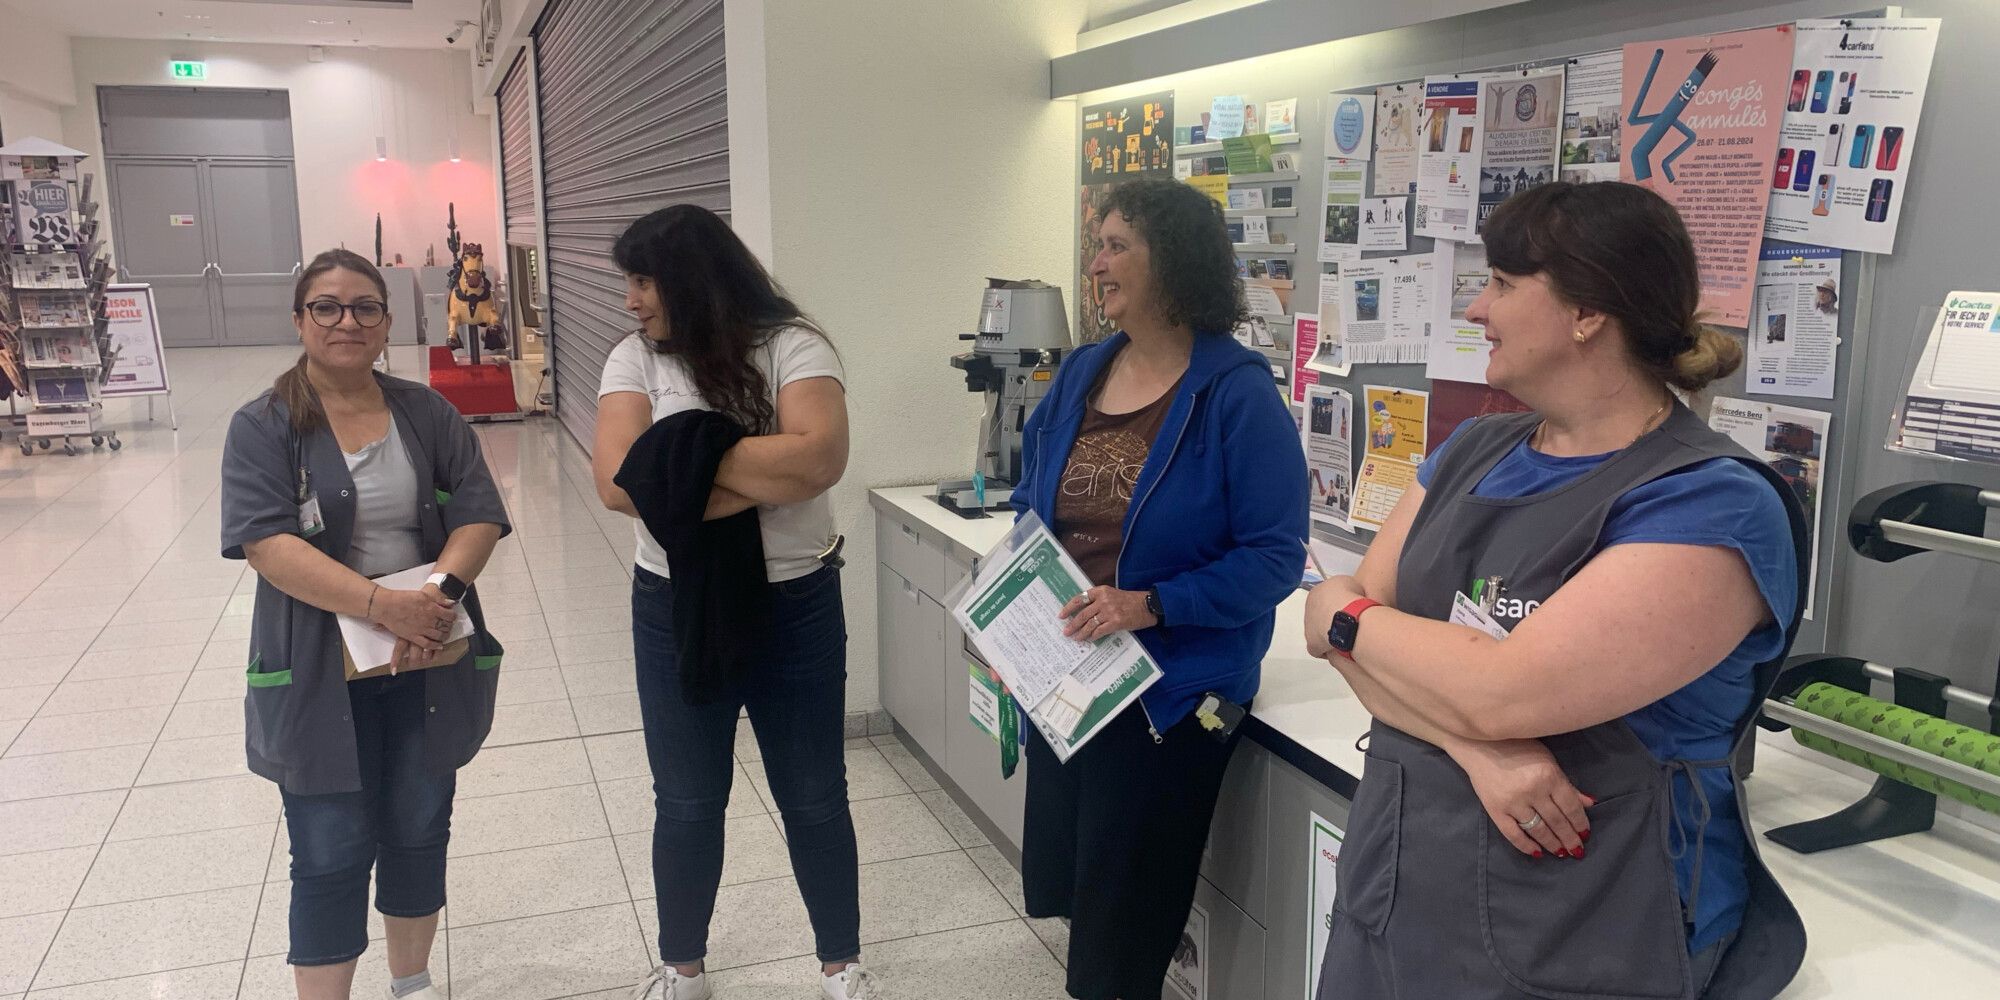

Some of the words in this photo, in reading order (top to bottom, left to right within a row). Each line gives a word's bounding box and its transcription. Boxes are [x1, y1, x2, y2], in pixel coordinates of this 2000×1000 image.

[1839, 33, 1875, 51] 4carfans
[1431, 85, 1449, 93] VENDRE
[1695, 80, 1763, 110] congés
[1686, 106, 1767, 129] annulés
[1494, 138, 1519, 147] DEMAIN
[34, 188, 65, 201] HIER
[1394, 275, 1411, 284] 17.499
[1412, 274, 1417, 282] €
[1958, 300, 1993, 310] Cactus
[1959, 311, 1977, 321] IECH
[1978, 312, 1990, 321] DO
[1964, 321, 1986, 329] SERVICE
[1746, 411, 1763, 419] Benz
